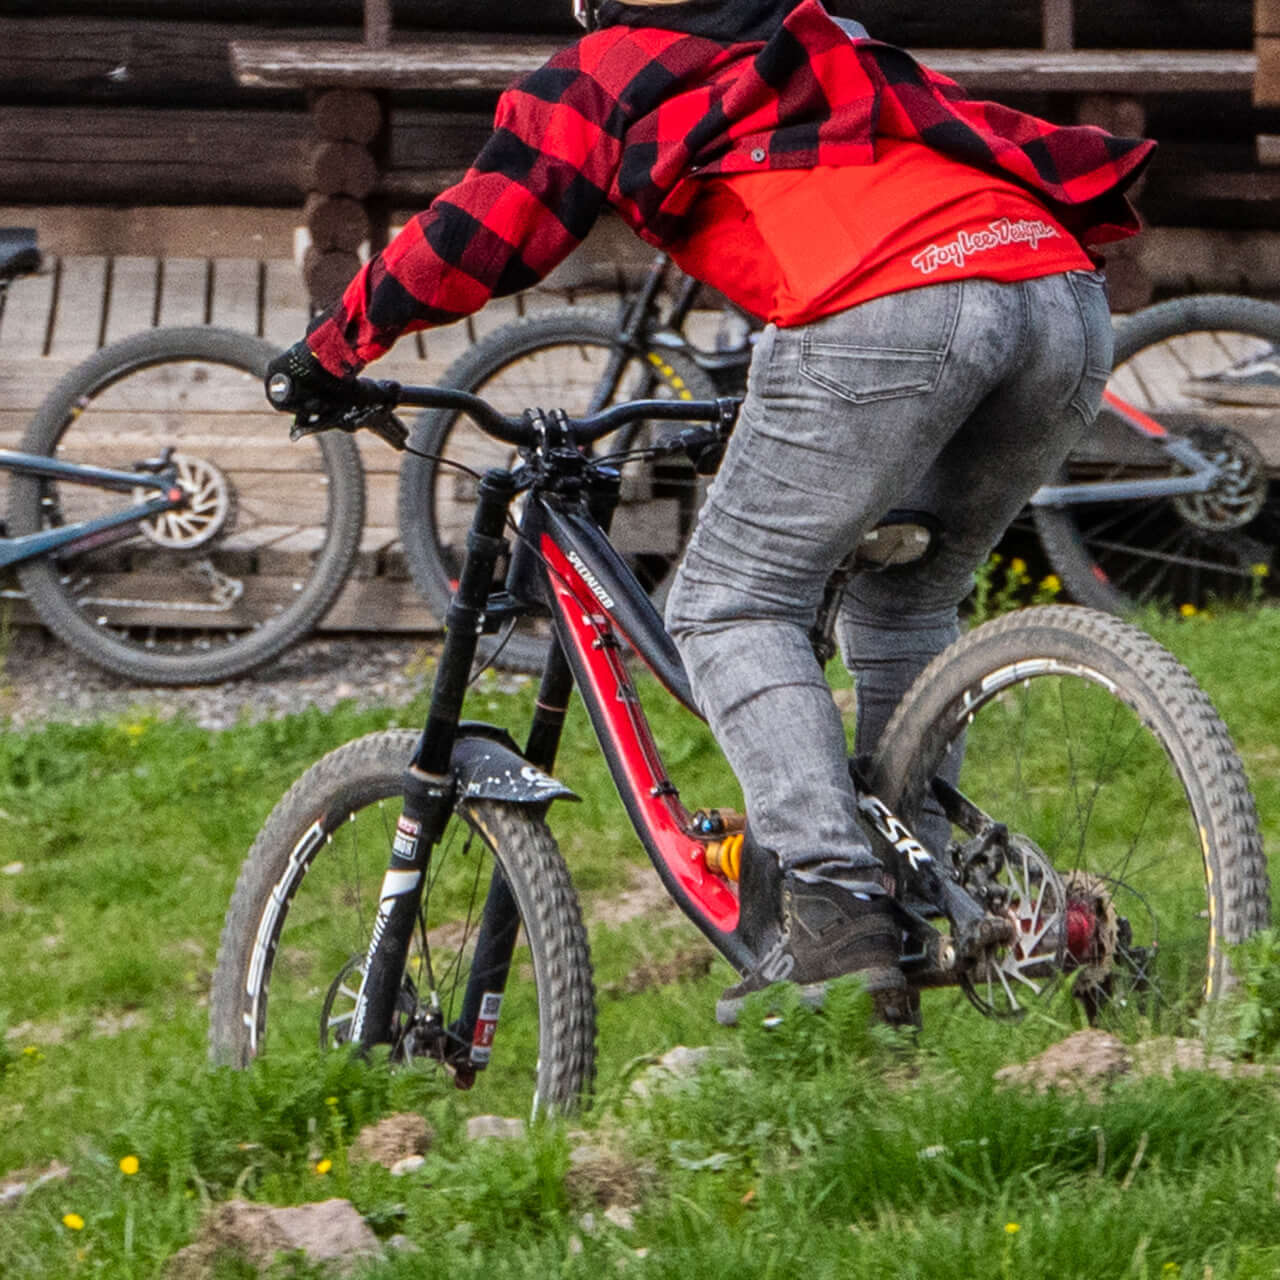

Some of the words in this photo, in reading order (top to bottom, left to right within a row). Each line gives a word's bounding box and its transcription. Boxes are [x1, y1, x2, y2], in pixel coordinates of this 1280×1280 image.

[912, 242, 965, 275] Troy
[957, 230, 996, 257] Lee
[567, 550, 615, 609] SPECIALIZED
